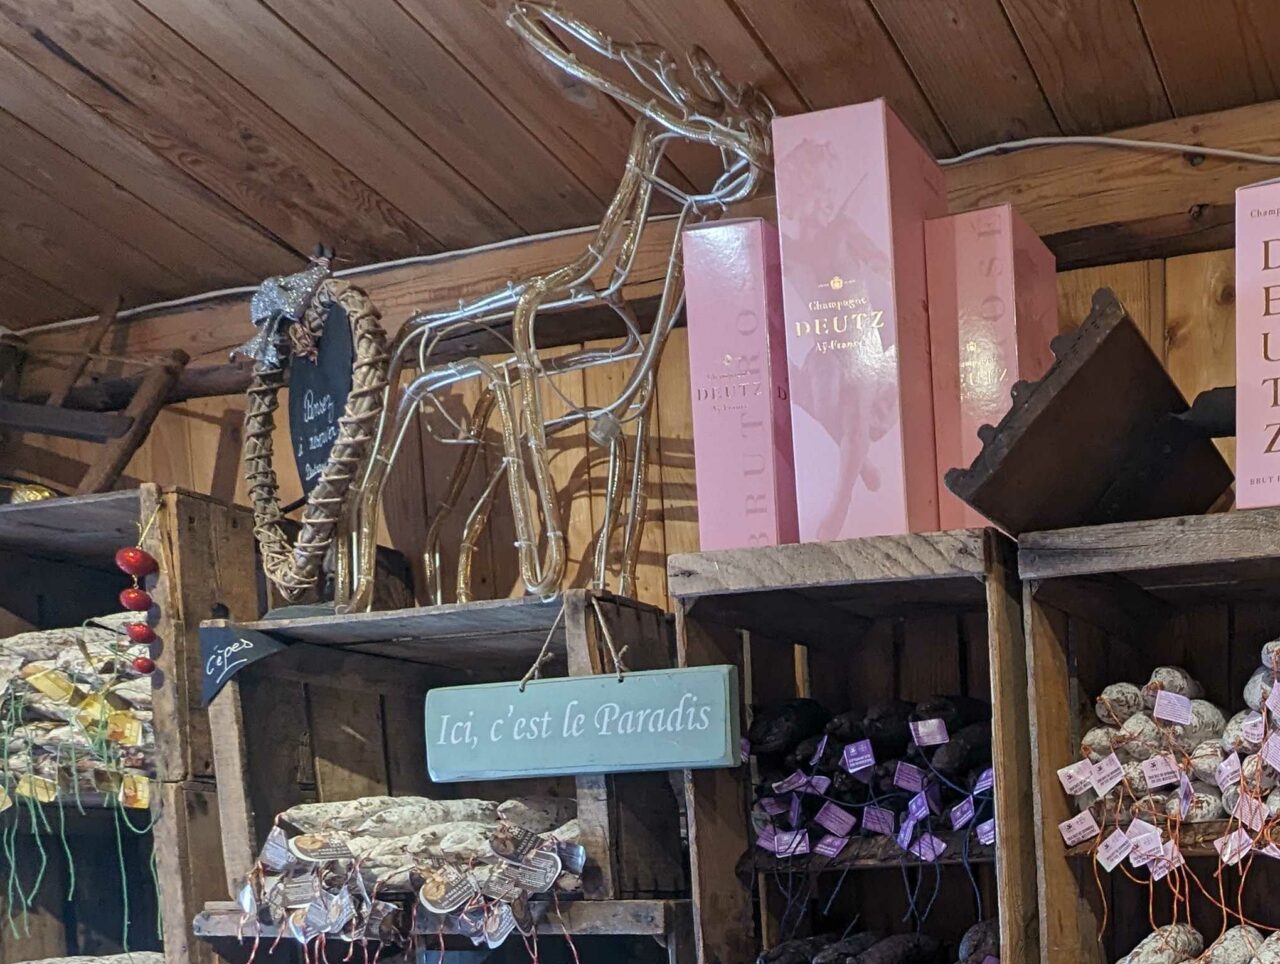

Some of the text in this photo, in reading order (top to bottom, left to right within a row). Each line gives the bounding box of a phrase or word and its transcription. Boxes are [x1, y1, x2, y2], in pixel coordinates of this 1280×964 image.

[808, 297, 867, 311] Champagne
[794, 311, 885, 337] DEUTZ
[1249, 476, 1275, 486] BRUT
[437, 692, 712, 750] Ici, c'est le Paradis
